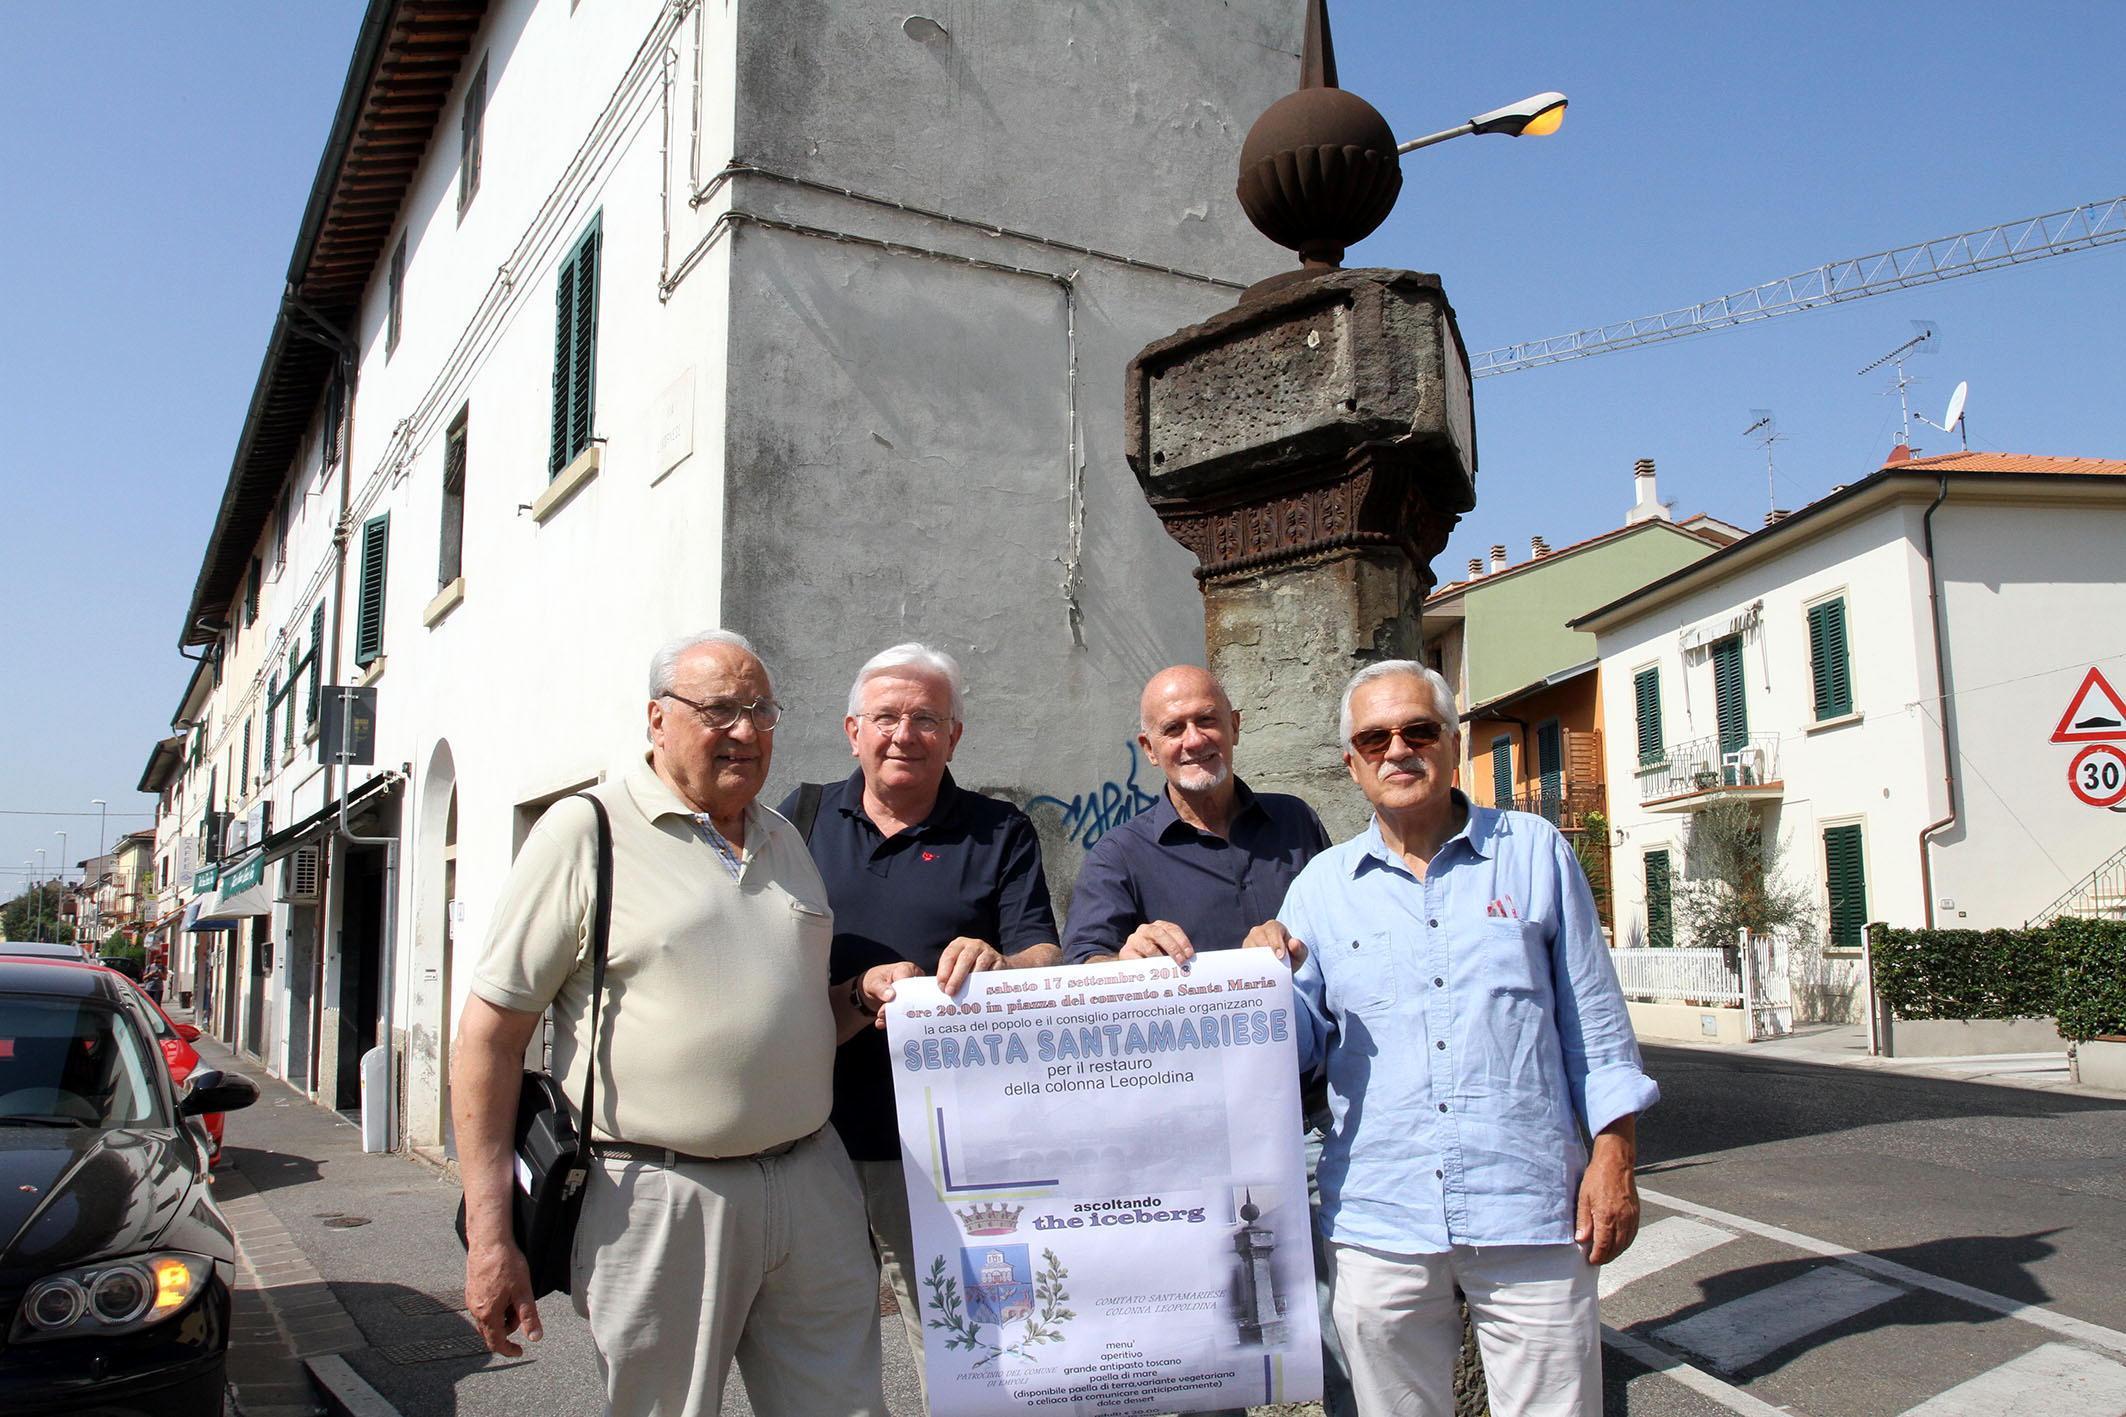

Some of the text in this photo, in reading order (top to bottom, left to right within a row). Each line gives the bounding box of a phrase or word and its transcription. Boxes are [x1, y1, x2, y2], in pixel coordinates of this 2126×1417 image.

[2083, 762, 2119, 790] 30
[986, 982, 1038, 995] sabato
[1044, 977, 1062, 990] 17
[1068, 972, 1145, 988] settembre
[906, 977, 1276, 1019] ore 20.00 in piazza del convento a Santa Maria
[924, 999, 1263, 1035] la casa del popolo e il consiglio parrocchiale organizzano
[904, 1009, 1288, 1072] SERATA SANTAMARIESE
[1047, 1058, 1152, 1079] per il restauro
[1004, 1071, 1194, 1096] della colonna Leopoldina
[1073, 1197, 1162, 1212] ascoltando
[1032, 1207, 1206, 1231] the iceberg
[1095, 1289, 1227, 1306] COMITATO SANTAMARIESE
[1105, 1301, 1217, 1317] COLONNA LEOPOLDINA
[1106, 1339, 1135, 1349] menu'
[1064, 1357, 1182, 1375] grande antipasto toscano
[1101, 1350, 1143, 1362] aperitivo
[1014, 1387, 1066, 1399] (disponibile
[1069, 1382, 1098, 1394] paella
[1101, 1381, 1109, 1391] di
[1178, 1371, 1235, 1383] vegetariana
[1089, 1369, 1158, 1383] paella di mare
[1036, 1396, 1068, 1406] celiaca
[1070, 1394, 1083, 1403] da
[1085, 1388, 1139, 1400] comunicare
[1142, 1381, 1223, 1396] anticipatamente)
[1097, 1395, 1155, 1407] dolce dessert
